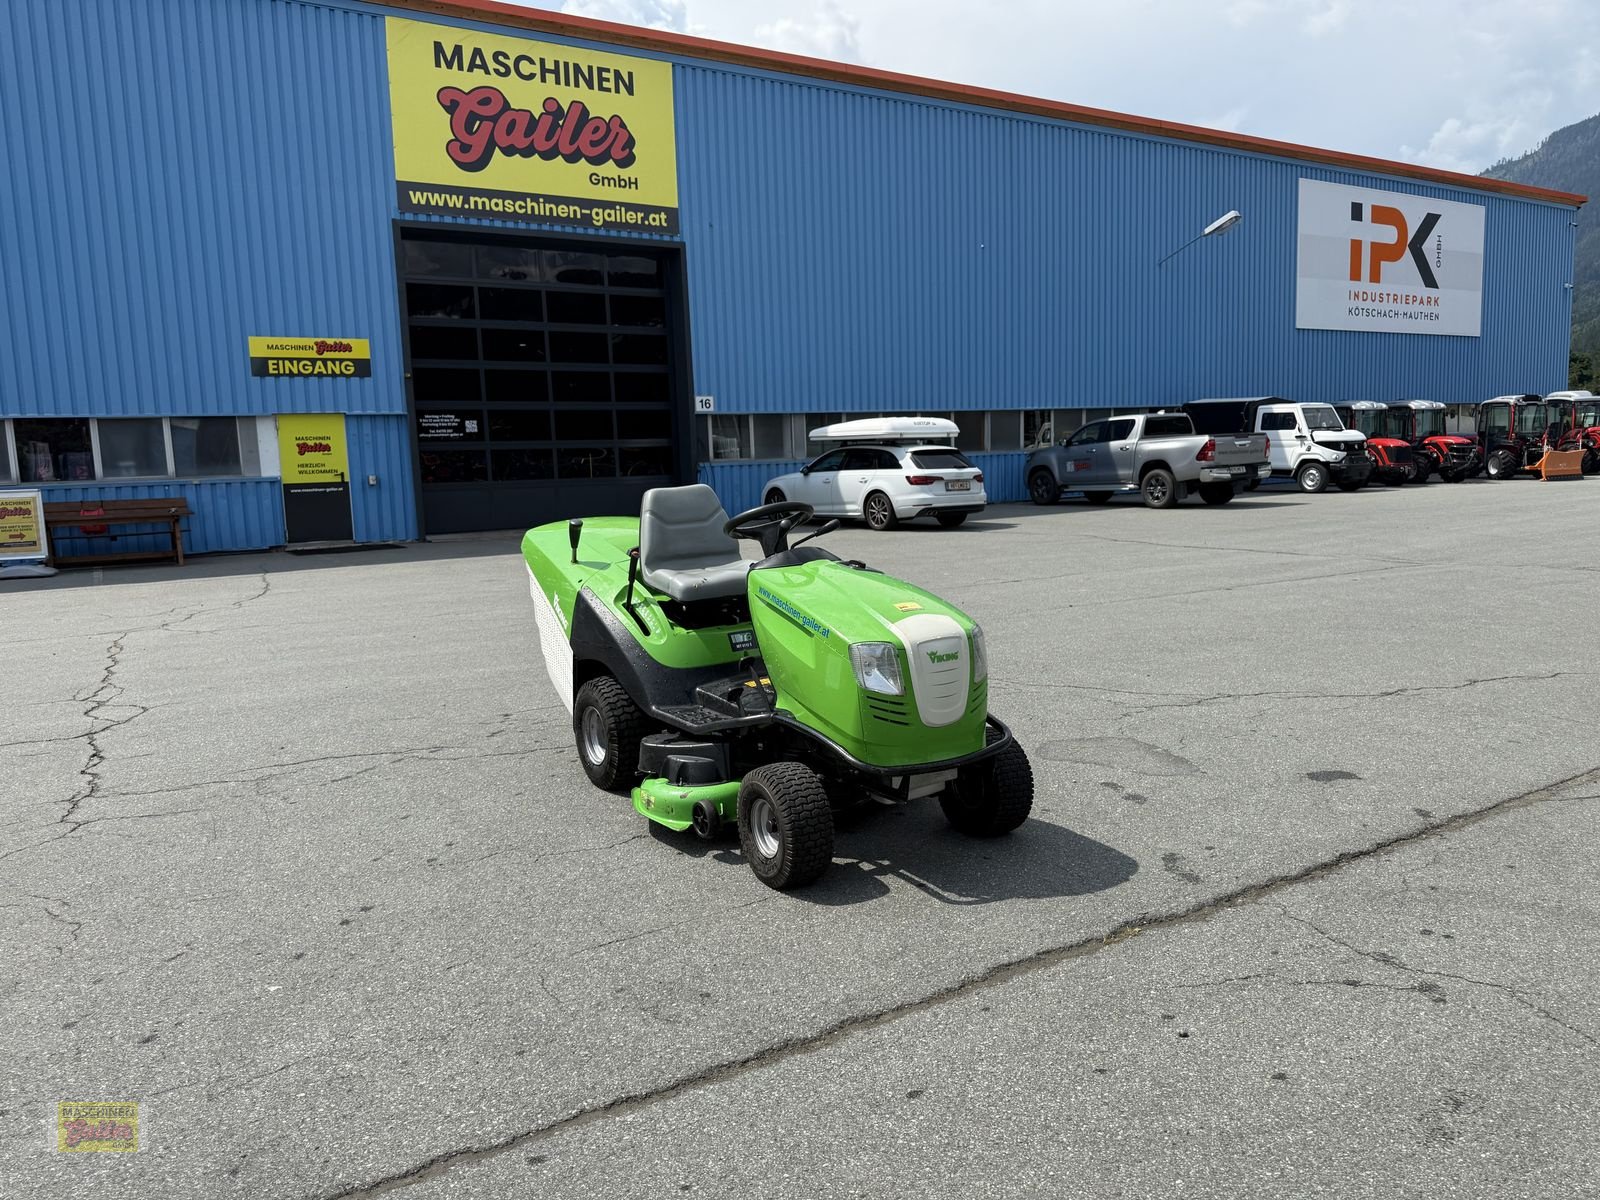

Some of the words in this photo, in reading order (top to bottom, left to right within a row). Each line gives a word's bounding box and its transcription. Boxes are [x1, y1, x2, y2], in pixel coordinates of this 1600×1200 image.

[433, 40, 635, 96] MASCHINEN
[436, 85, 636, 172] Gailer
[588, 172, 639, 190] GmbH
[408, 189, 668, 227] www.maschinen-gailer.at
[1348, 290, 1440, 307] INDUSTRIEPARK
[1348, 306, 1440, 321] KÖTSCHACH-MAUTHEN
[266, 343, 314, 351] MASCHINEN
[313, 340, 352, 356] Gailer
[268, 360, 355, 374] EINGANG
[699, 398, 711, 409] 16
[758, 586, 830, 638] www.maschinen-gailer.at
[926, 651, 959, 664] VIKING
